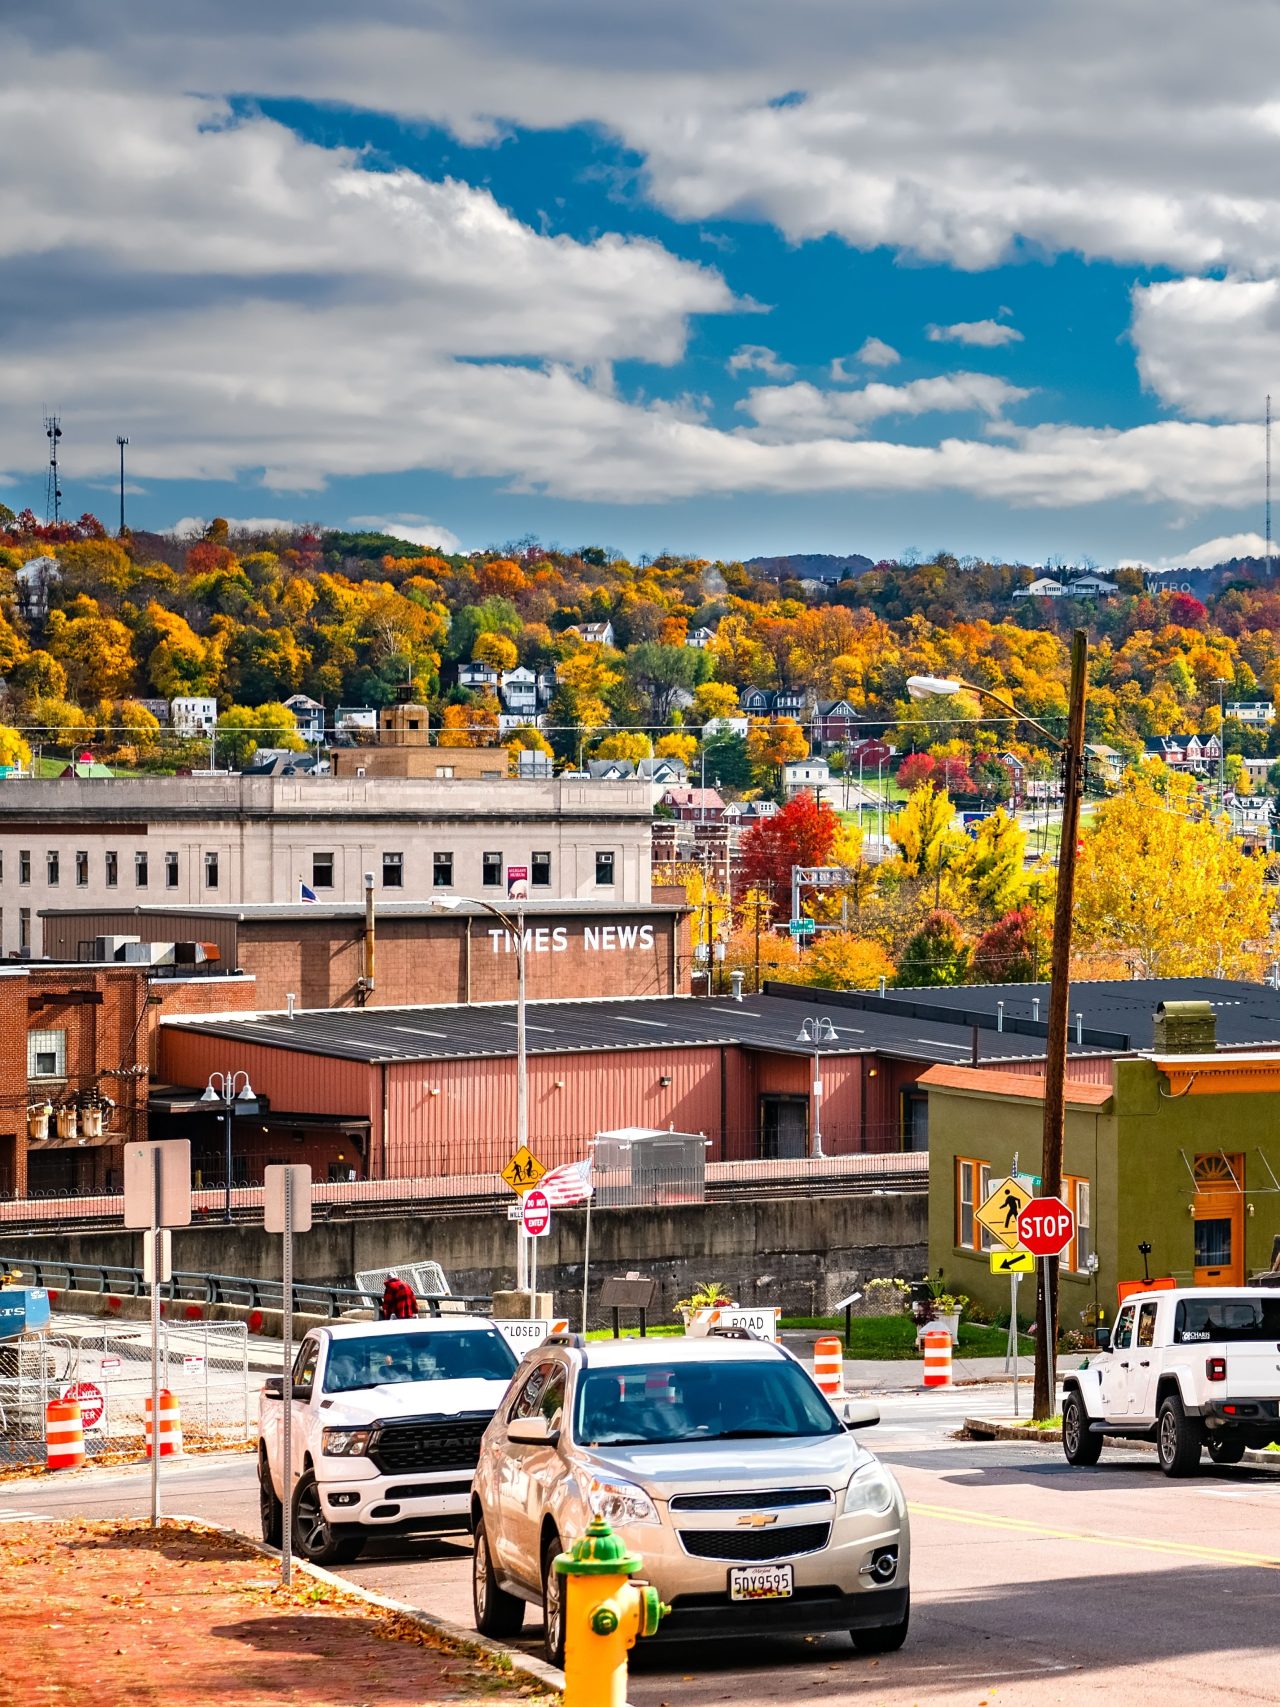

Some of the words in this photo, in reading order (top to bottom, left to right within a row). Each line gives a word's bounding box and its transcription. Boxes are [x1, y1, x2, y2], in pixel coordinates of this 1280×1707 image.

[488, 927, 567, 953] TIMES
[583, 925, 654, 950] NEWS
[527, 1199, 535, 1208] DO
[536, 1198, 546, 1206] NOT
[528, 1219, 544, 1227] ENTER
[1021, 1215, 1070, 1239] STOP
[732, 1317, 764, 1329] ROAD
[80, 1411, 96, 1420] TER
[734, 1573, 789, 1594] 5DY9595
